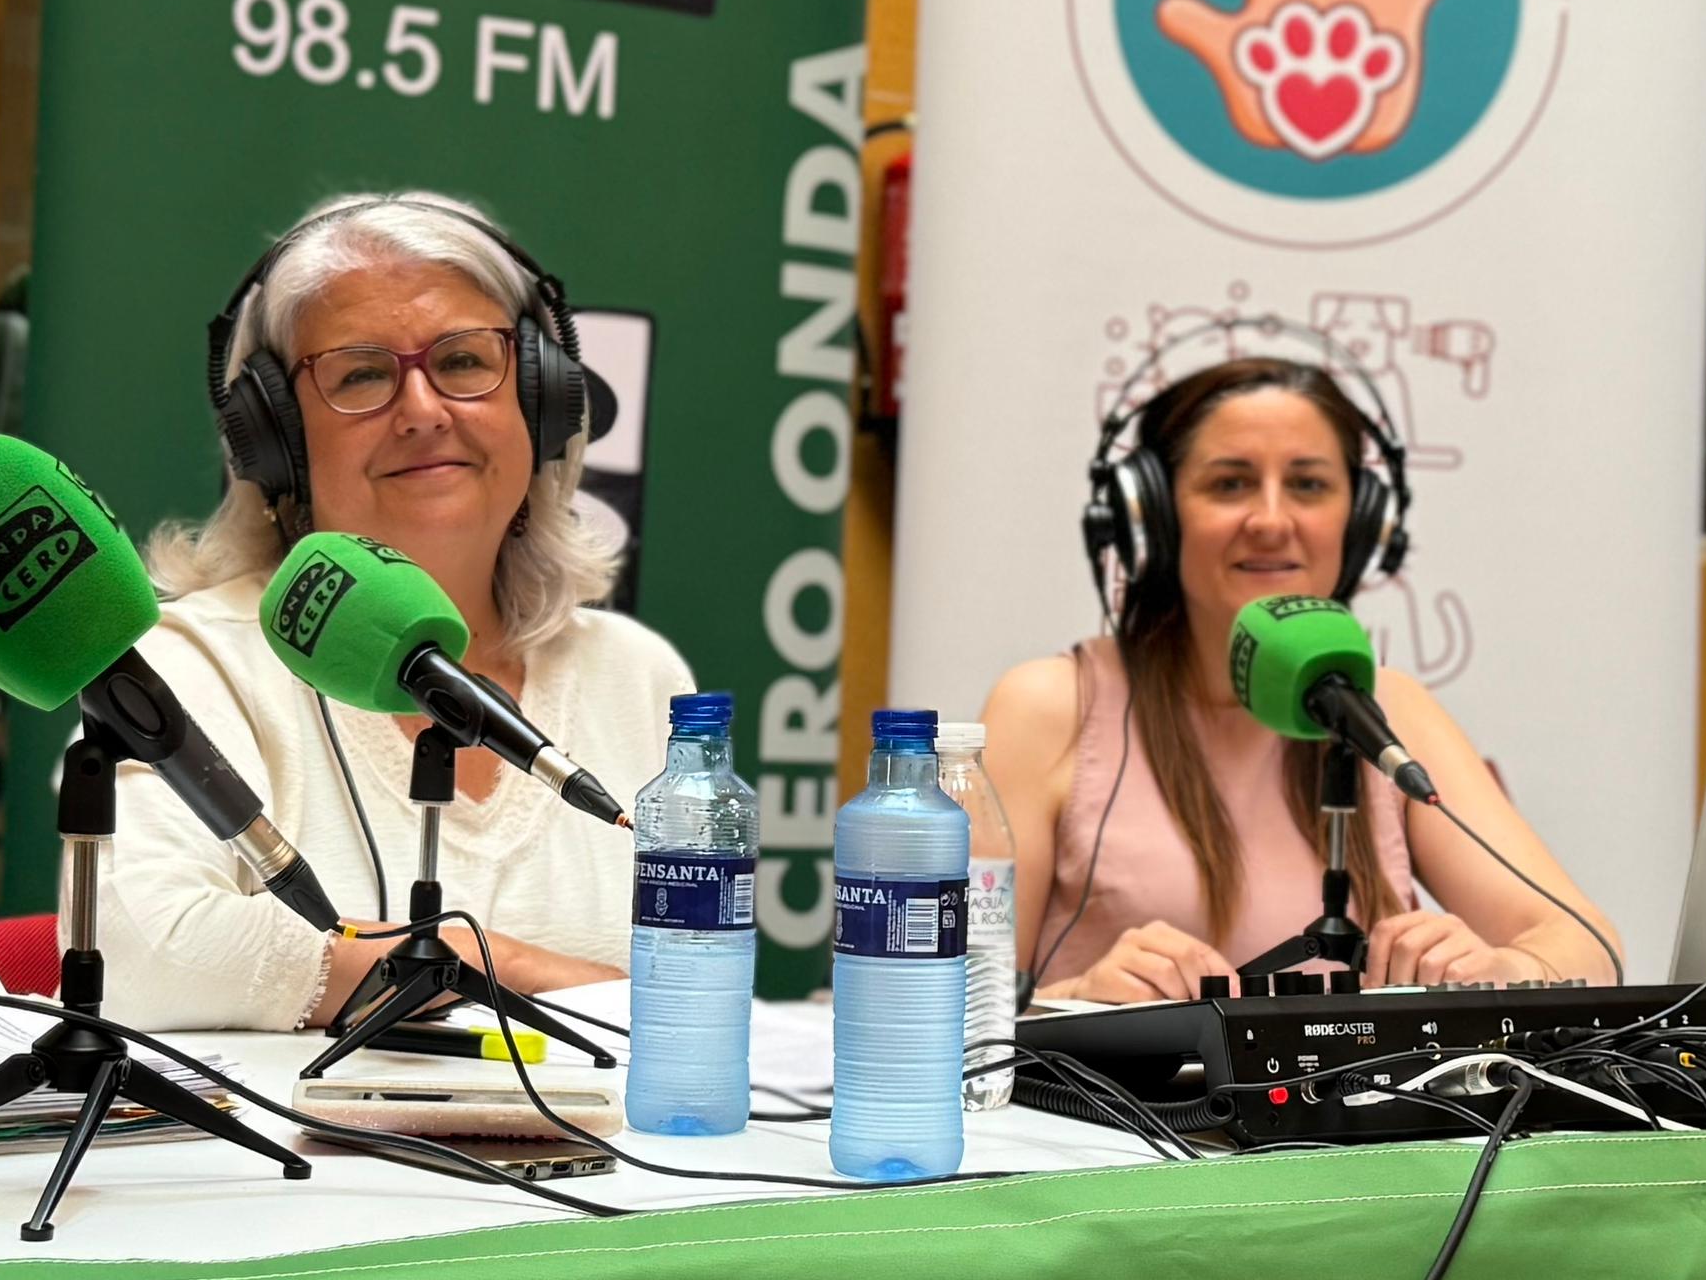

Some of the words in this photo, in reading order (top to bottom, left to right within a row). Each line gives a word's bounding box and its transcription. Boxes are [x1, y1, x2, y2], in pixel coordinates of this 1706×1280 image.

[475, 15, 618, 120] FM
[771, 43, 868, 515] ONDA
[2, 537, 69, 601] CERO
[282, 568, 321, 626] ONDA
[299, 578, 337, 636] CERO
[757, 548, 845, 952] CERO
[1357, 1035, 1376, 1045] PRO
